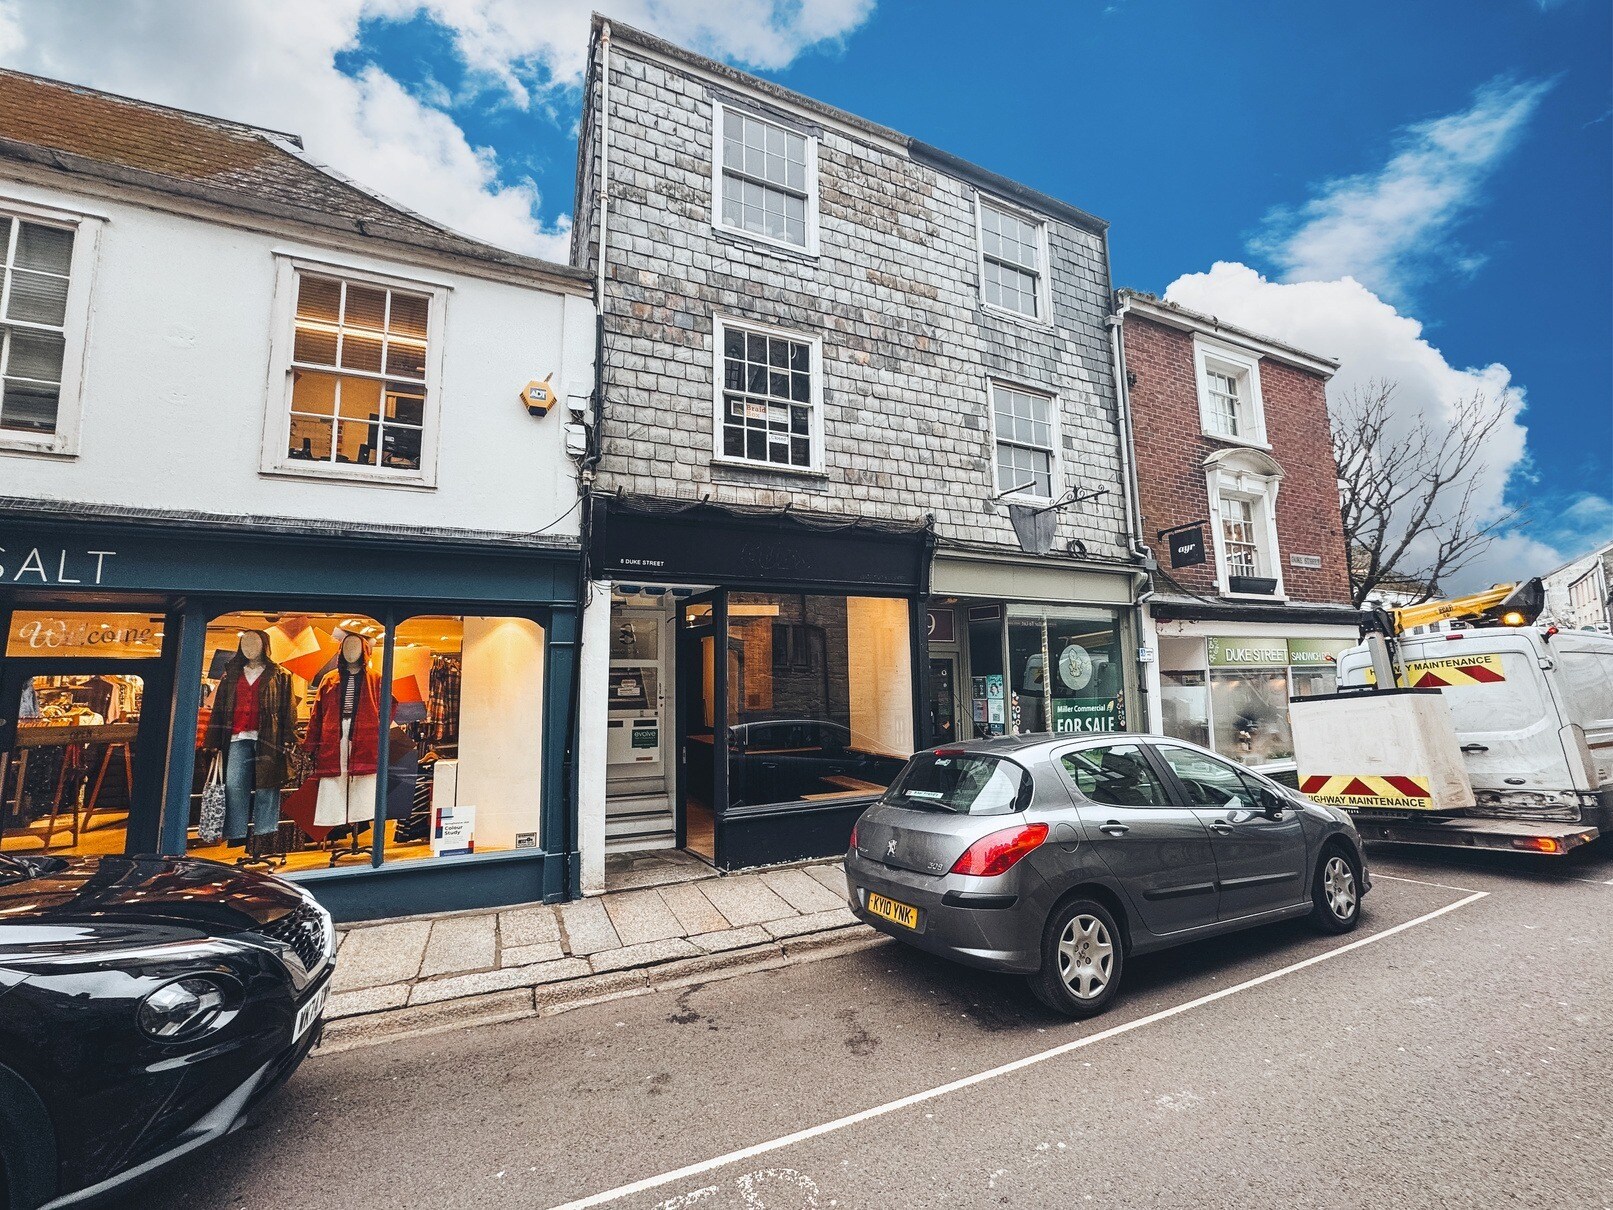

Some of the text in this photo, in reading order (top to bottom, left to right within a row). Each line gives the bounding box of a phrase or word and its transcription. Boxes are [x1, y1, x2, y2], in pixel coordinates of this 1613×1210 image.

[530, 389, 546, 399] ADT
[746, 404, 767, 413] Braid
[1178, 543, 1196, 554] ayr
[1225, 648, 1253, 662] DUKE
[1253, 648, 1288, 662] STREET
[1414, 656, 1493, 671] MAINTENANCE
[1057, 704, 1105, 713] Miller Commercial
[1057, 717, 1115, 732] FOR SALE
[1348, 797, 1426, 807] MAINTENANCE
[873, 895, 912, 924] KY10 YNK
